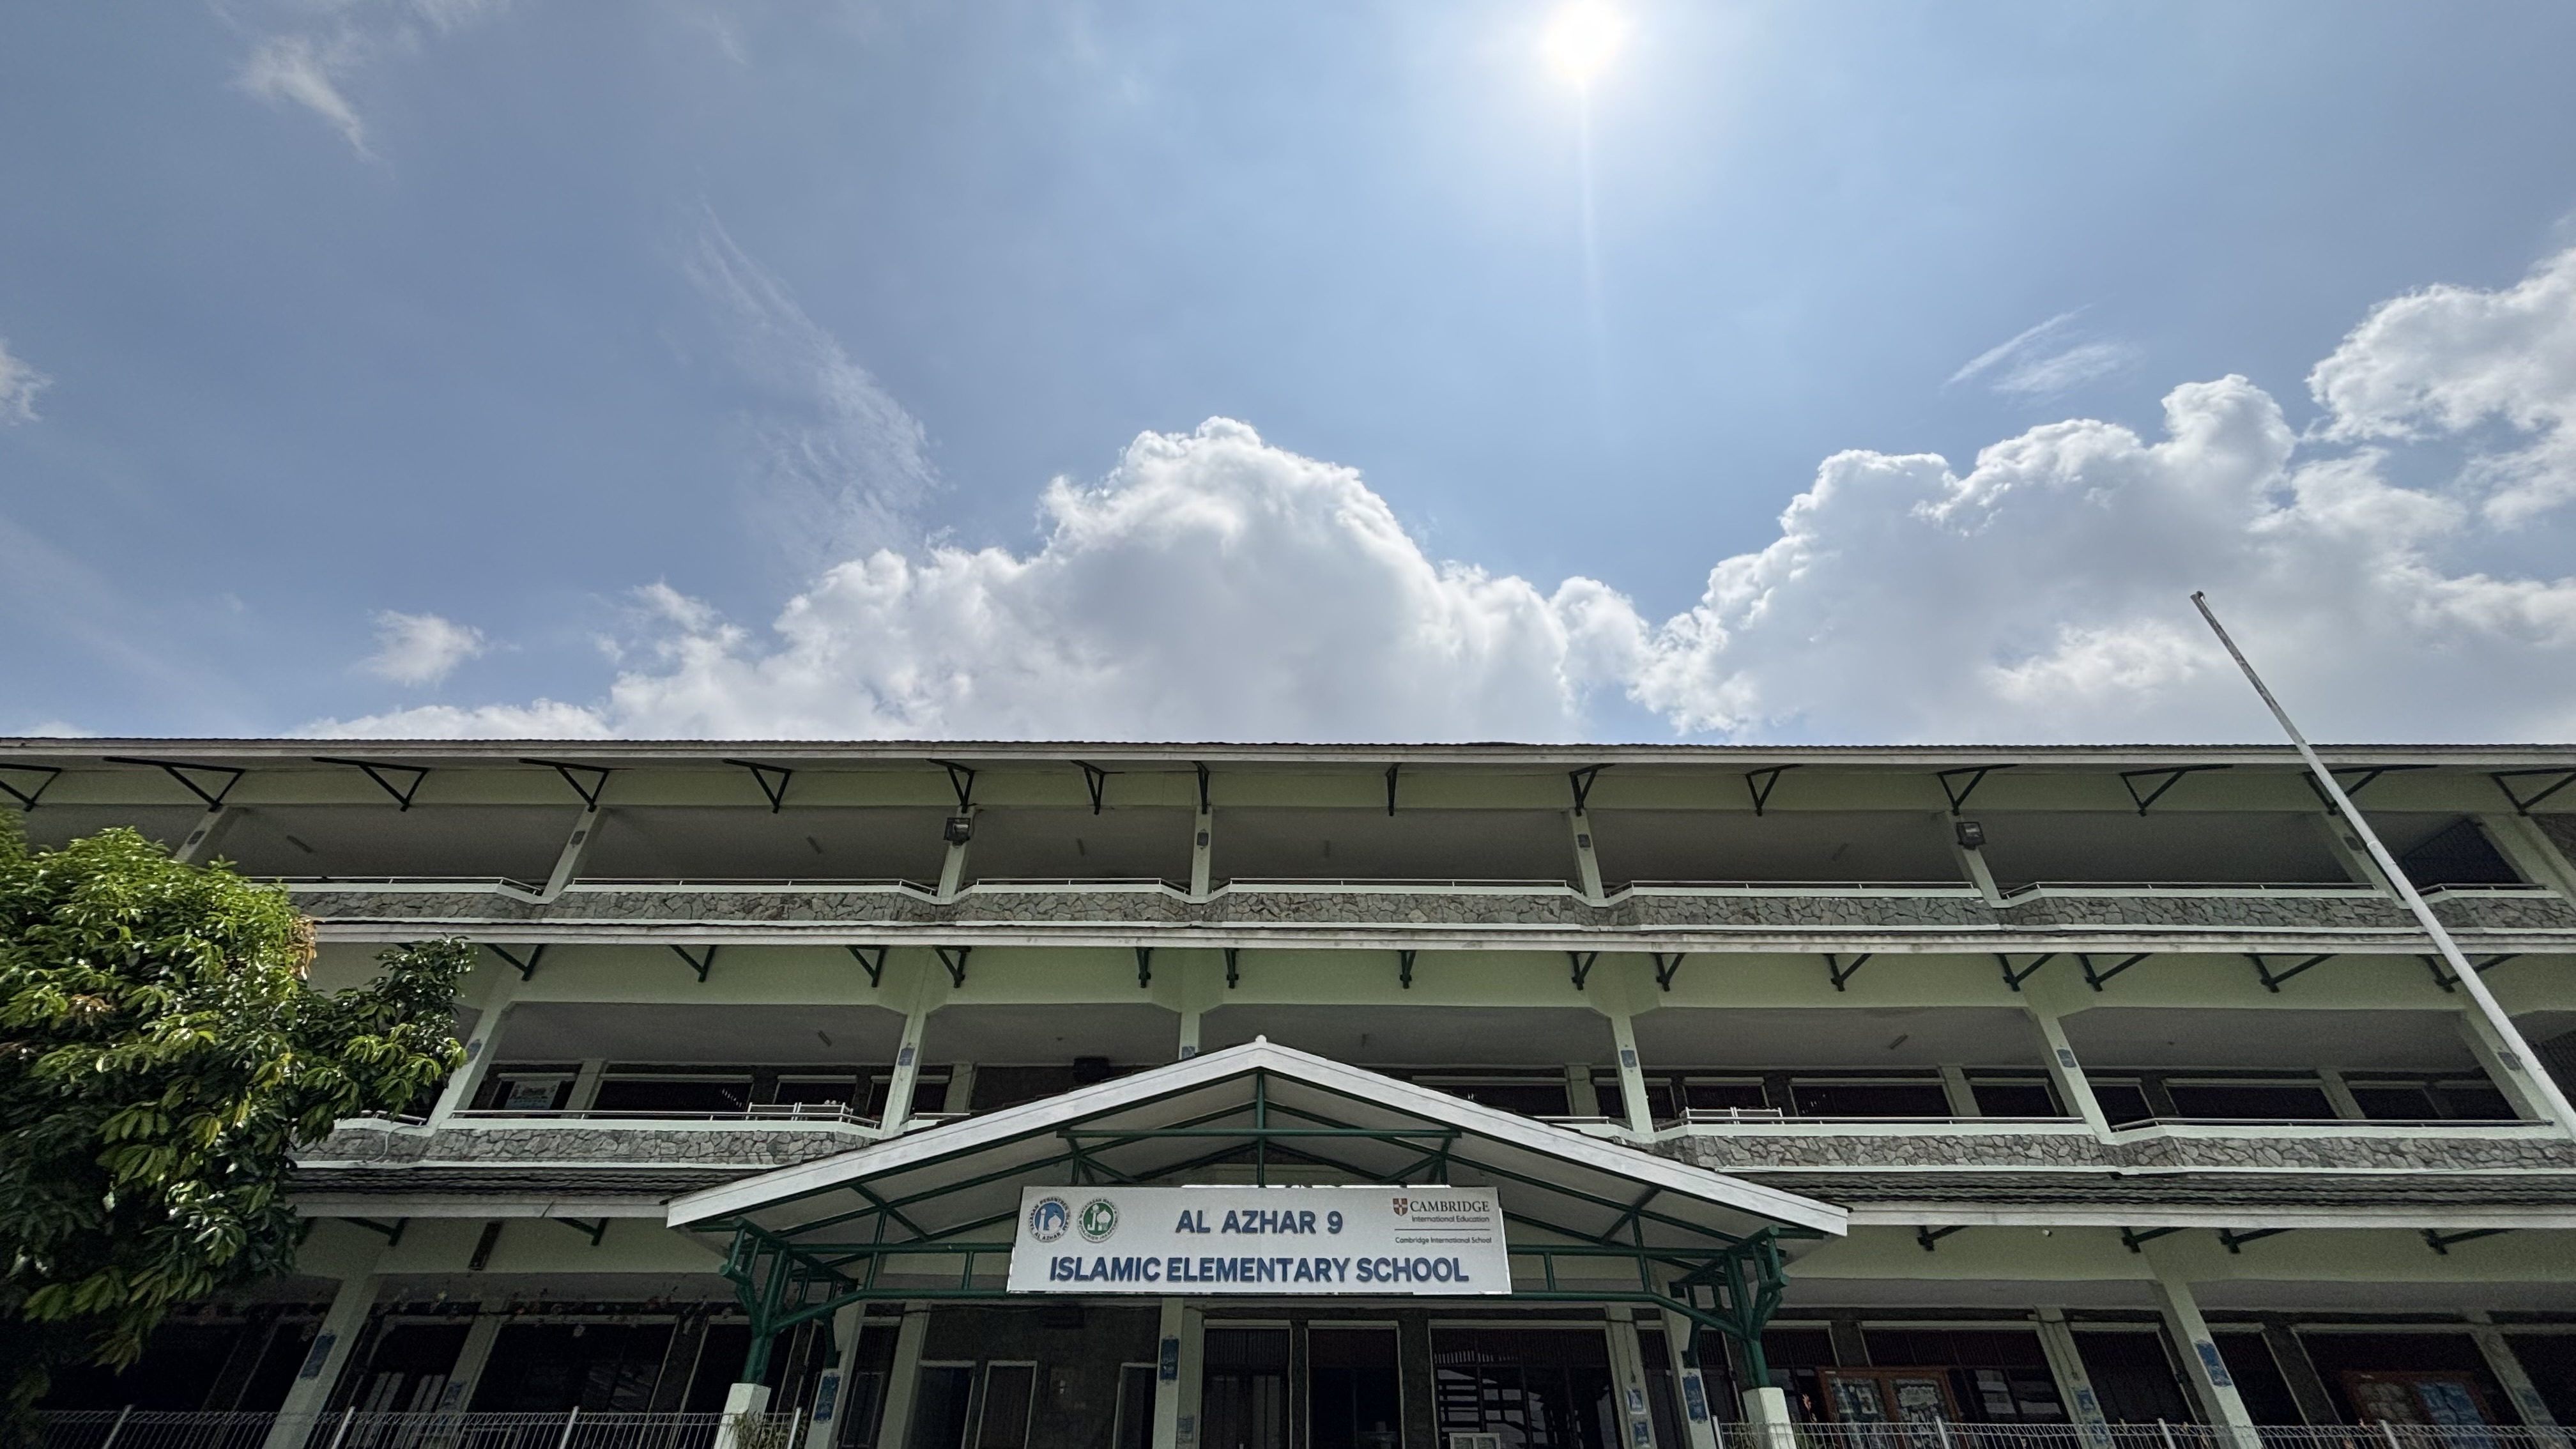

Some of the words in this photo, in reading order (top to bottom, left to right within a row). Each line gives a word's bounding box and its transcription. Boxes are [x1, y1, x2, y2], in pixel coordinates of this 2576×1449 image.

[1410, 1200, 1490, 1212] CAMBRIDGE
[1175, 1210, 1211, 1233] AL
[1221, 1210, 1316, 1234] AZHAR
[1327, 1210, 1343, 1234] 9
[1050, 1257, 1162, 1282] ISLAMIC
[1167, 1257, 1351, 1282] ELEMENTARY
[1356, 1257, 1469, 1282] SCHOOL
